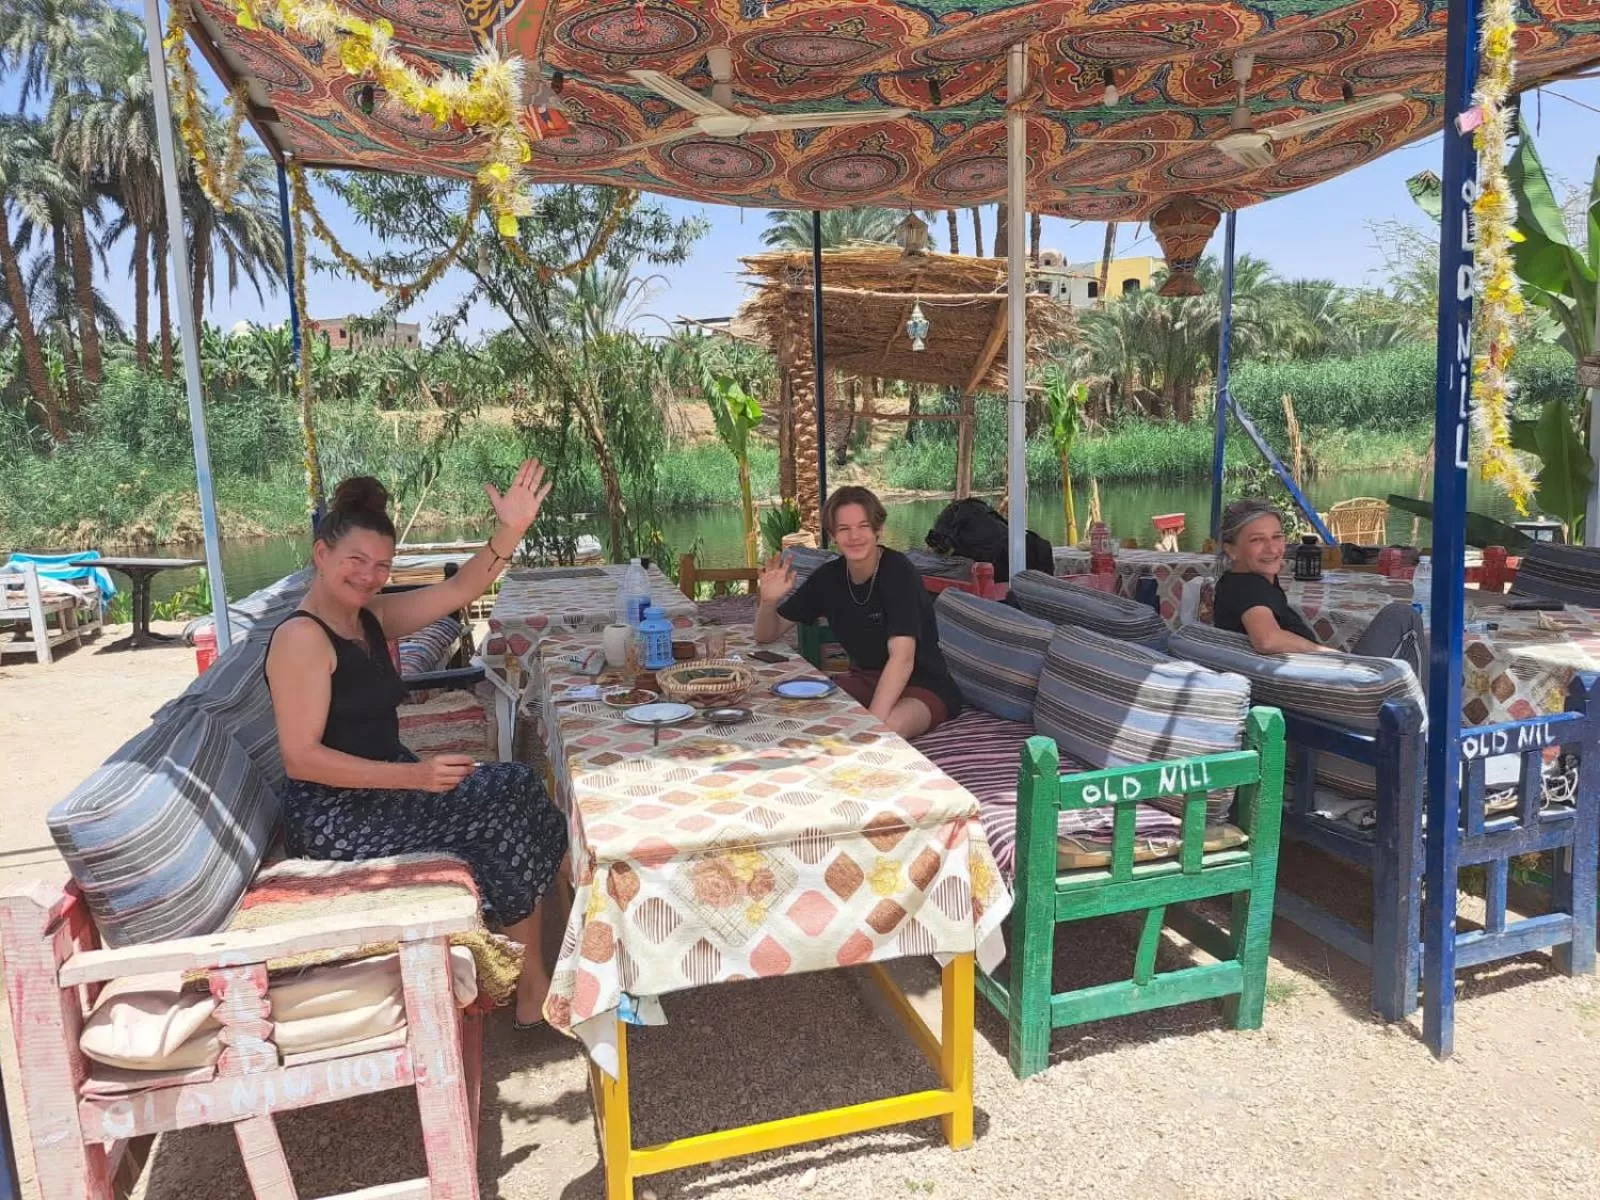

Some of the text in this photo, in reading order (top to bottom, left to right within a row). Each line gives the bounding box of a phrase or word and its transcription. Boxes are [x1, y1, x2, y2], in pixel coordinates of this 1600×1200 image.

[1457, 179, 1476, 301] OLD
[1462, 729, 1508, 760] OLD
[1082, 775, 1142, 803] OLD
